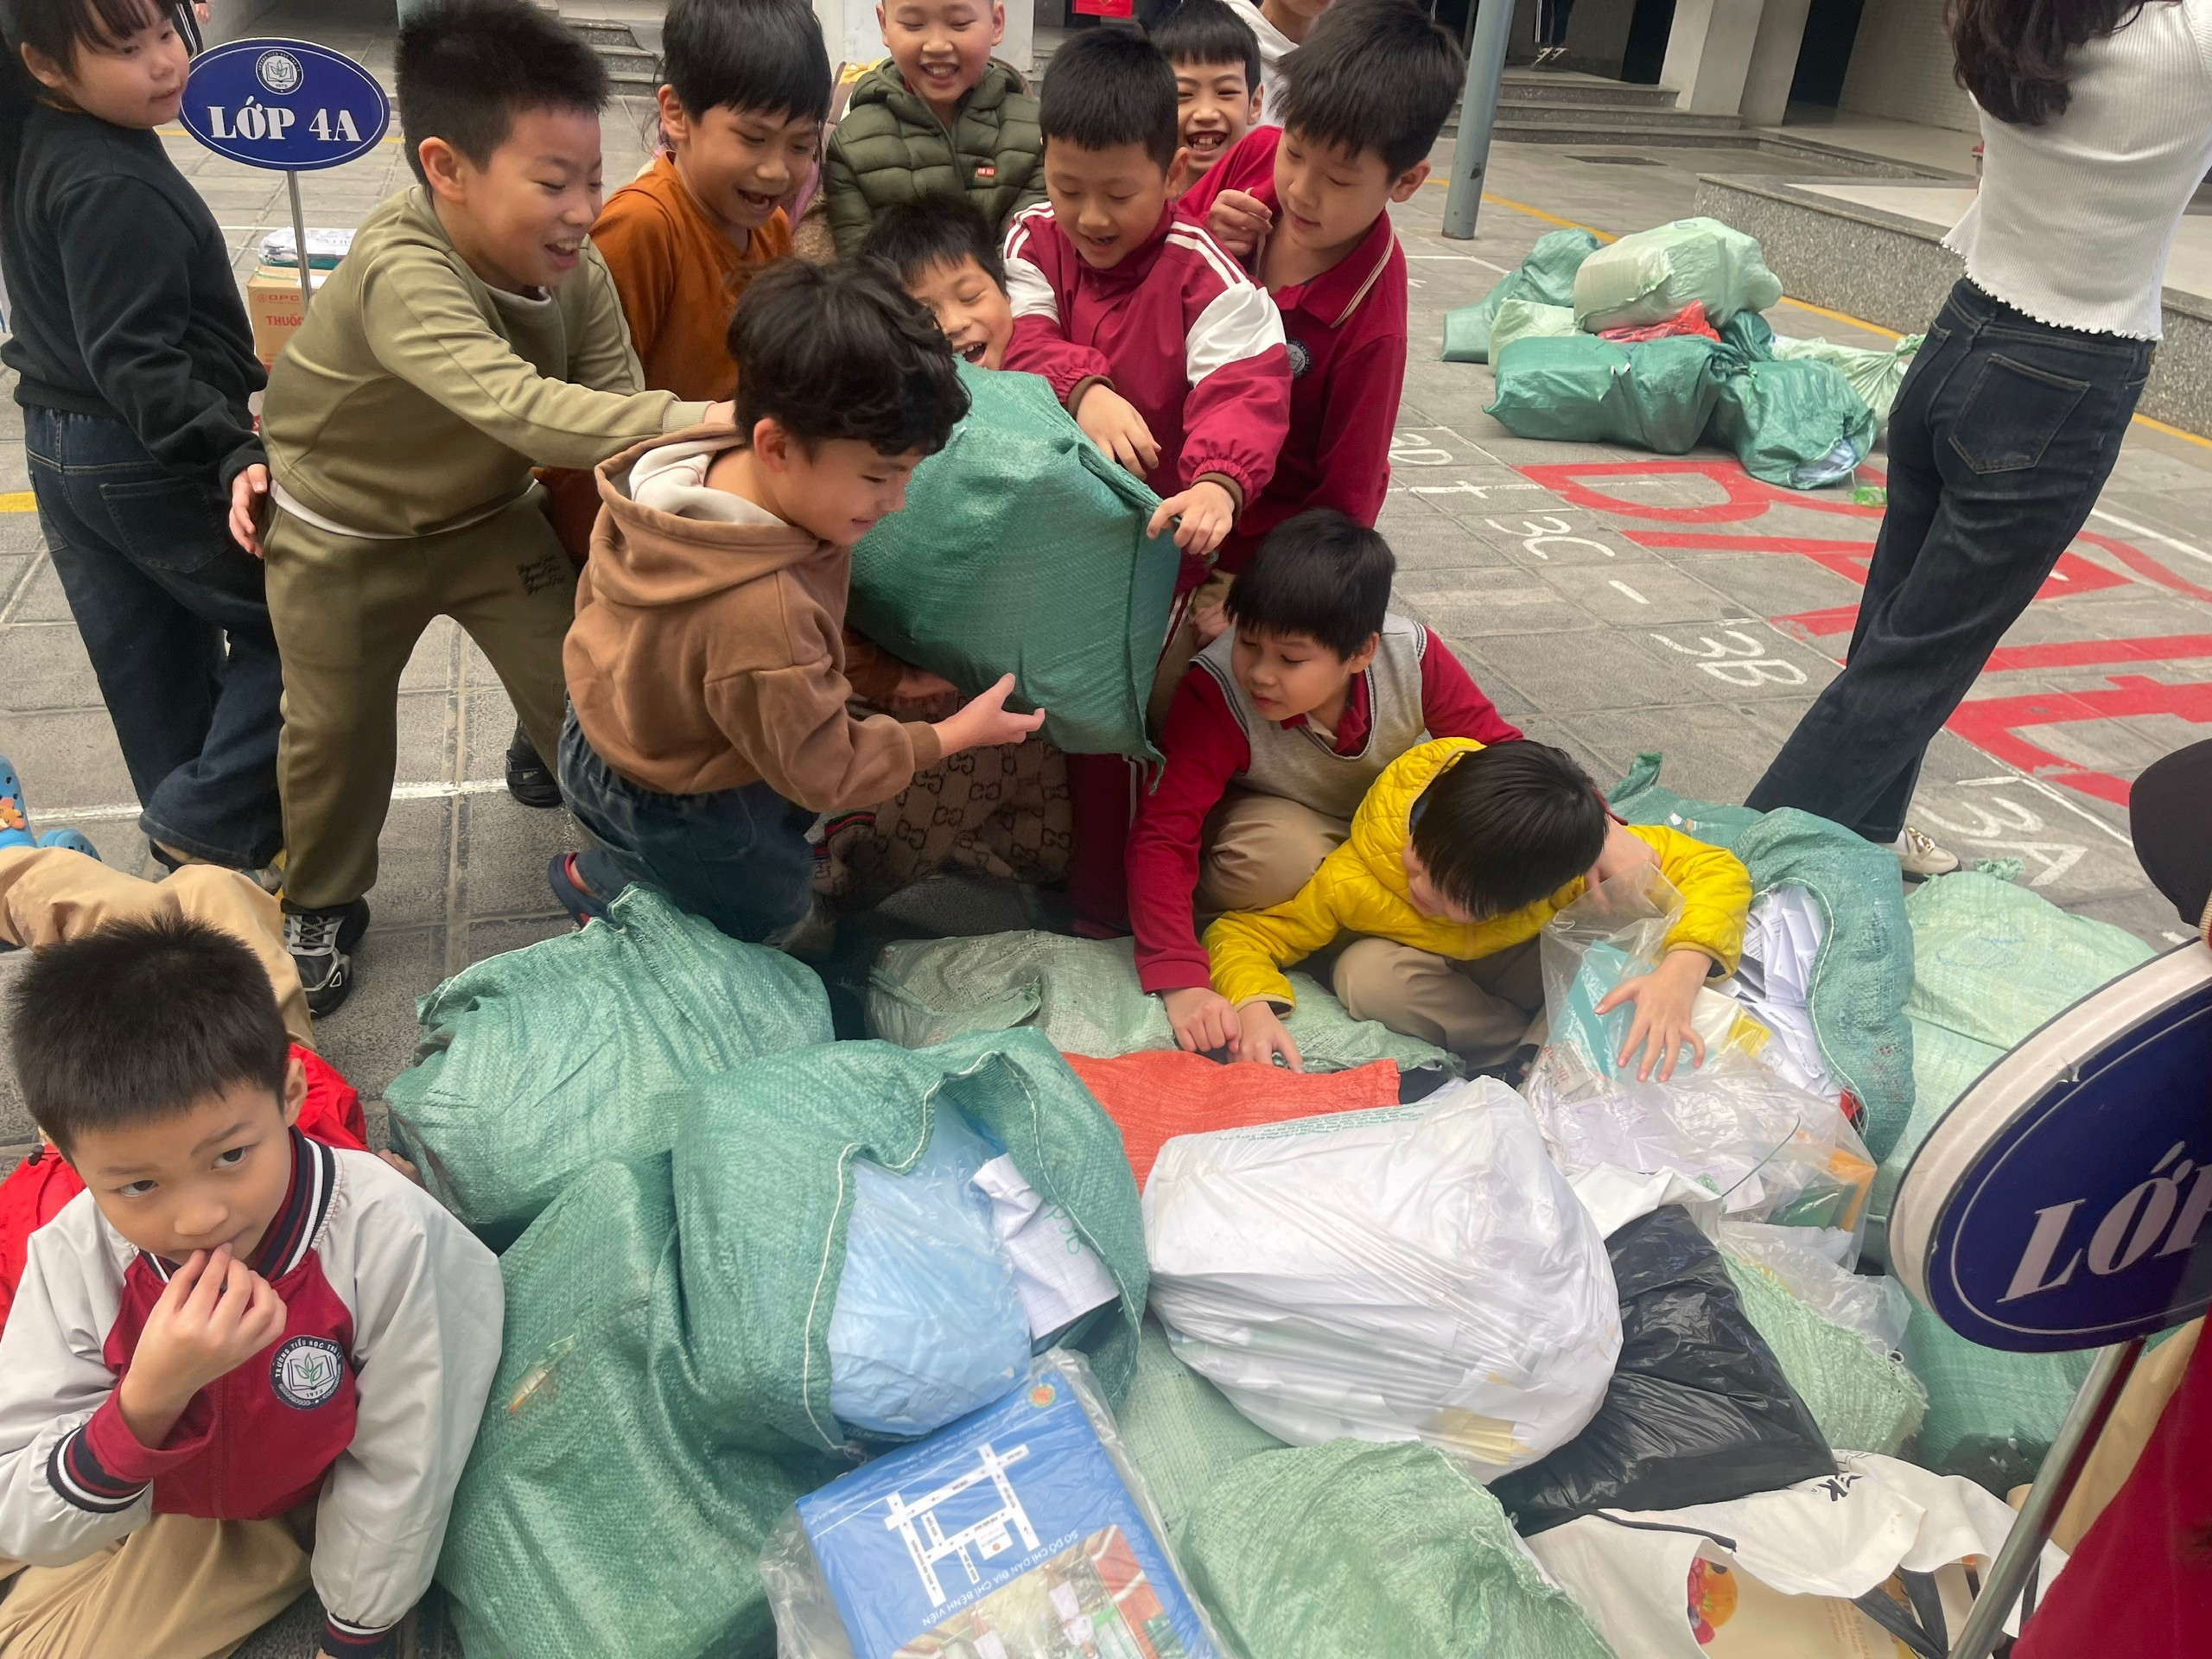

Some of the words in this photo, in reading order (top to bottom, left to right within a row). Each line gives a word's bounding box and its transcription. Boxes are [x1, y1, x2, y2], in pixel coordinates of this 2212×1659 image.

[207, 95, 296, 141] LỚP
[308, 108, 362, 142] 4A
[1484, 516, 1616, 560] 3C
[1649, 629, 1808, 688] 3B
[308, 1339, 325, 1349] HỌC
[306, 1389, 324, 1398] 1973
